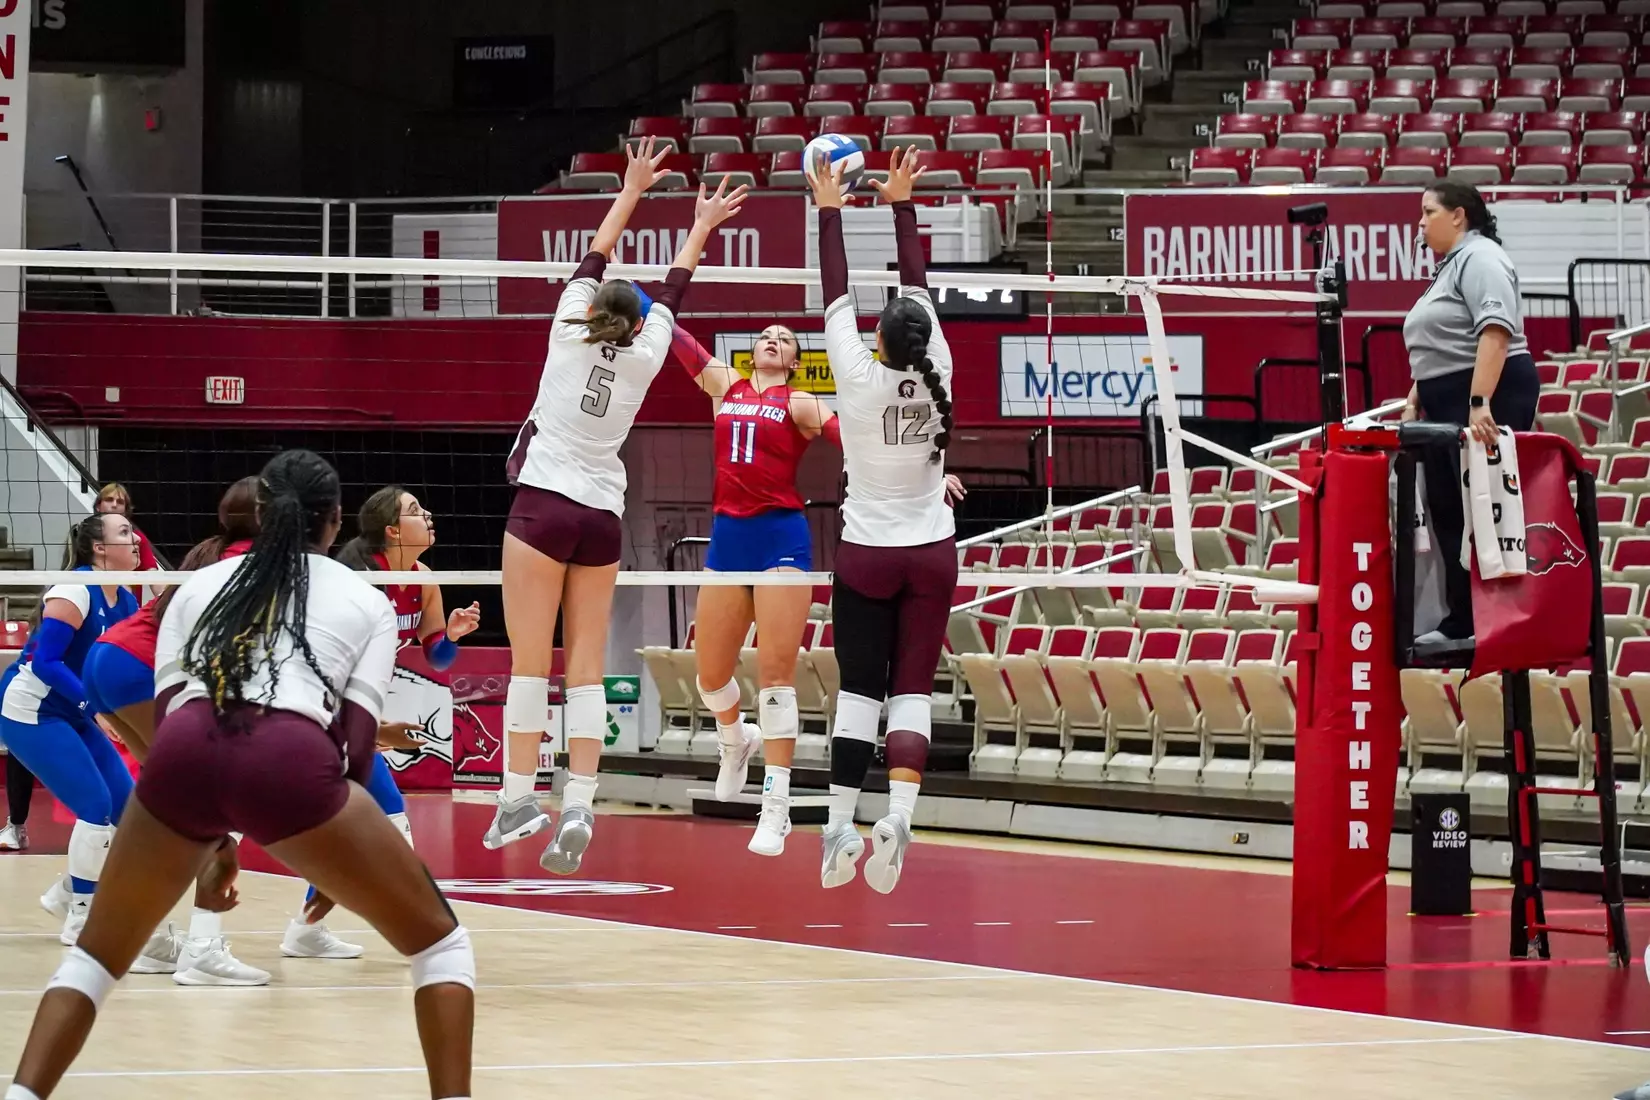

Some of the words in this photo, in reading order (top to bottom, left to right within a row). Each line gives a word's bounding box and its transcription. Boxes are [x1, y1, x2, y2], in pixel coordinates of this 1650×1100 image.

[1110, 228, 1124, 240] 12
[1144, 225, 1310, 282] BARNHILL
[1322, 224, 1436, 281] ARENA
[213, 378, 240, 401] EXIT
[580, 365, 616, 418] 5
[1025, 361, 1144, 408] Mercy
[758, 404, 787, 423] TECH
[882, 403, 932, 445] 12
[730, 420, 757, 464] 11
[1348, 542, 1374, 850] TOGETHER
[1432, 831, 1467, 840] VIDEO
[1441, 809, 1459, 830] SEC
[1432, 840, 1467, 849] REVIEW
